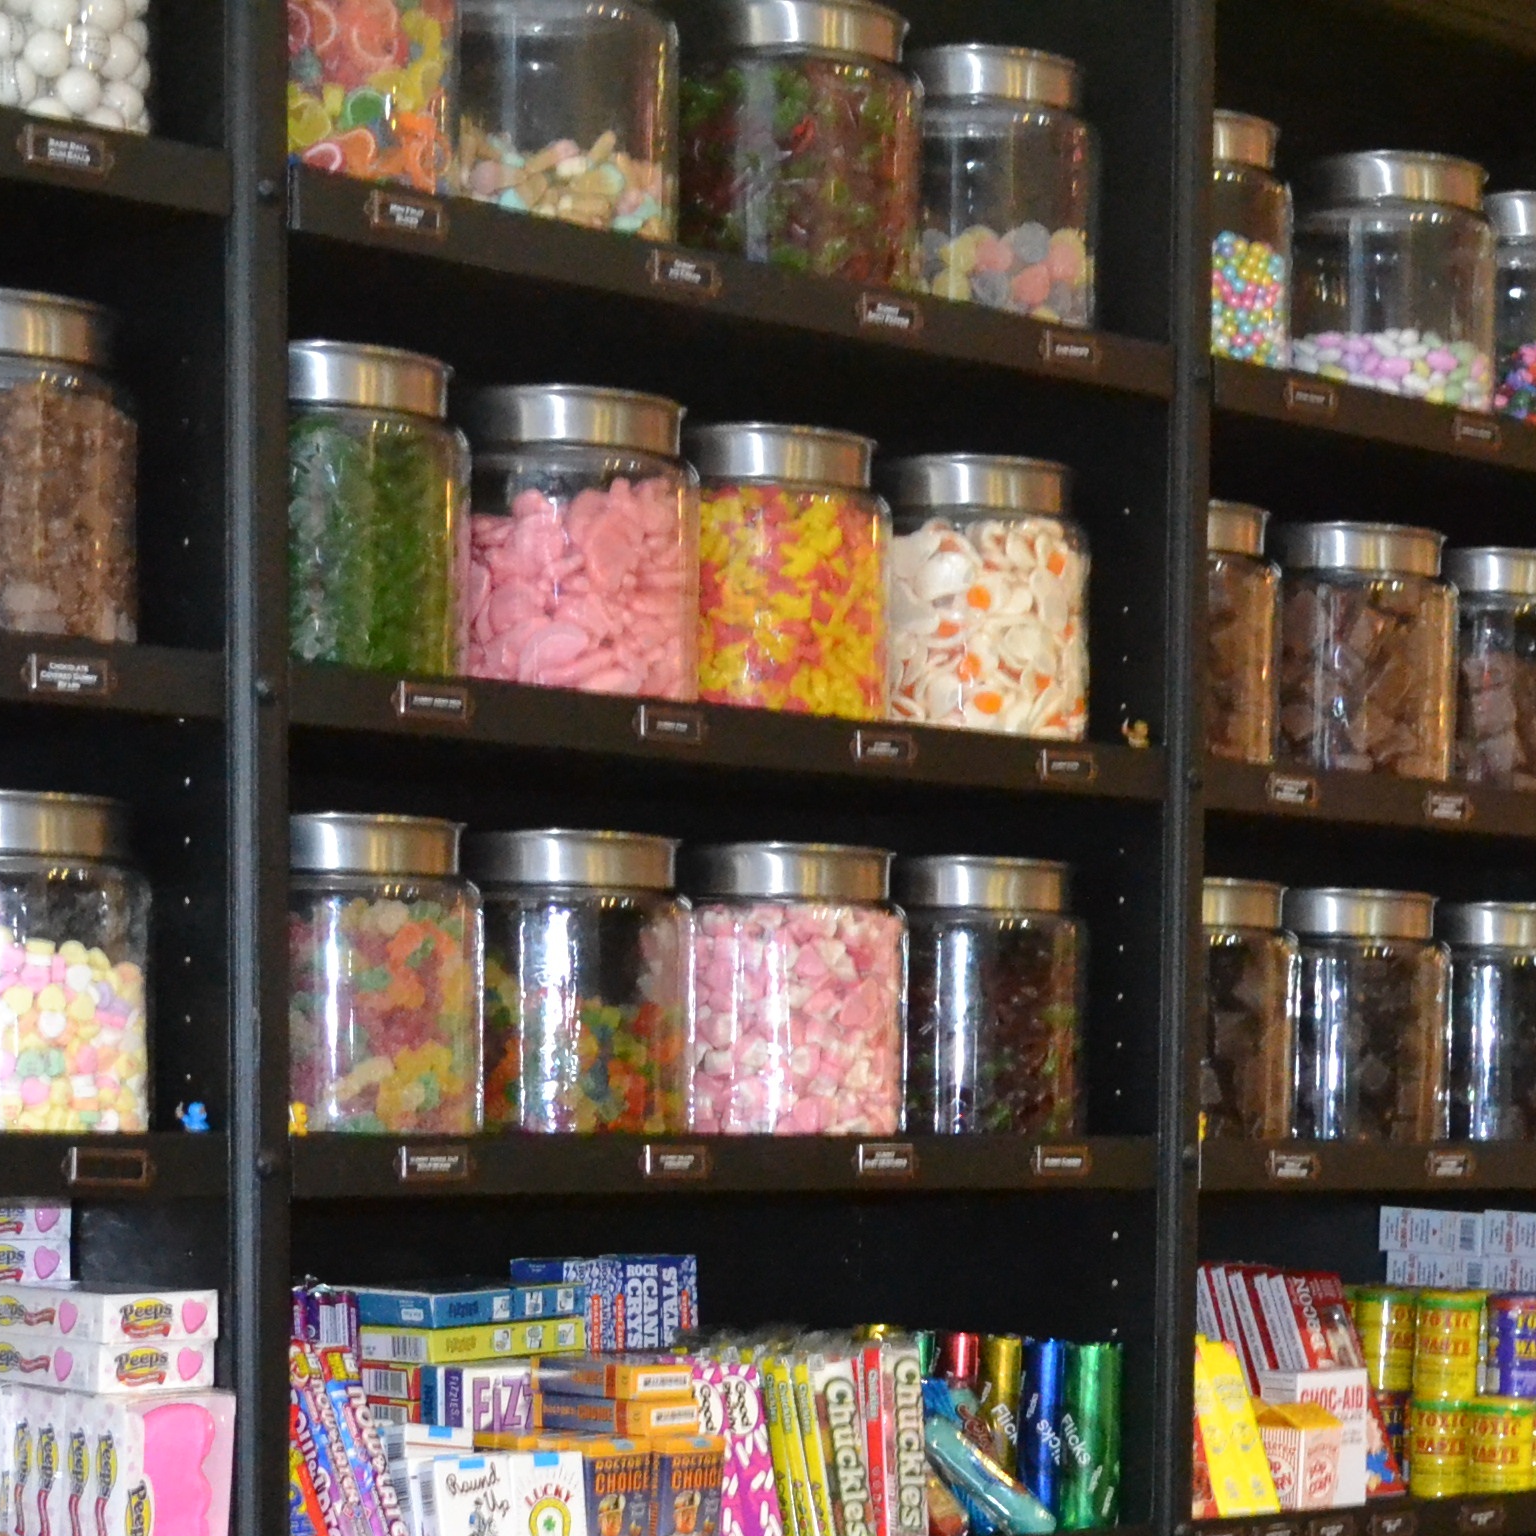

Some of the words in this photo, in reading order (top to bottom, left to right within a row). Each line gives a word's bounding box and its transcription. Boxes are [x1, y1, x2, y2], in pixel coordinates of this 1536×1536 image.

[119, 1301, 173, 1326] Peeps
[114, 1349, 169, 1374] Peeps
[894, 1357, 927, 1529] Chuckles
[1062, 1412, 1092, 1467] Flicks
[524, 1482, 576, 1508] LUCKY
[594, 1471, 650, 1494] CHOICE
